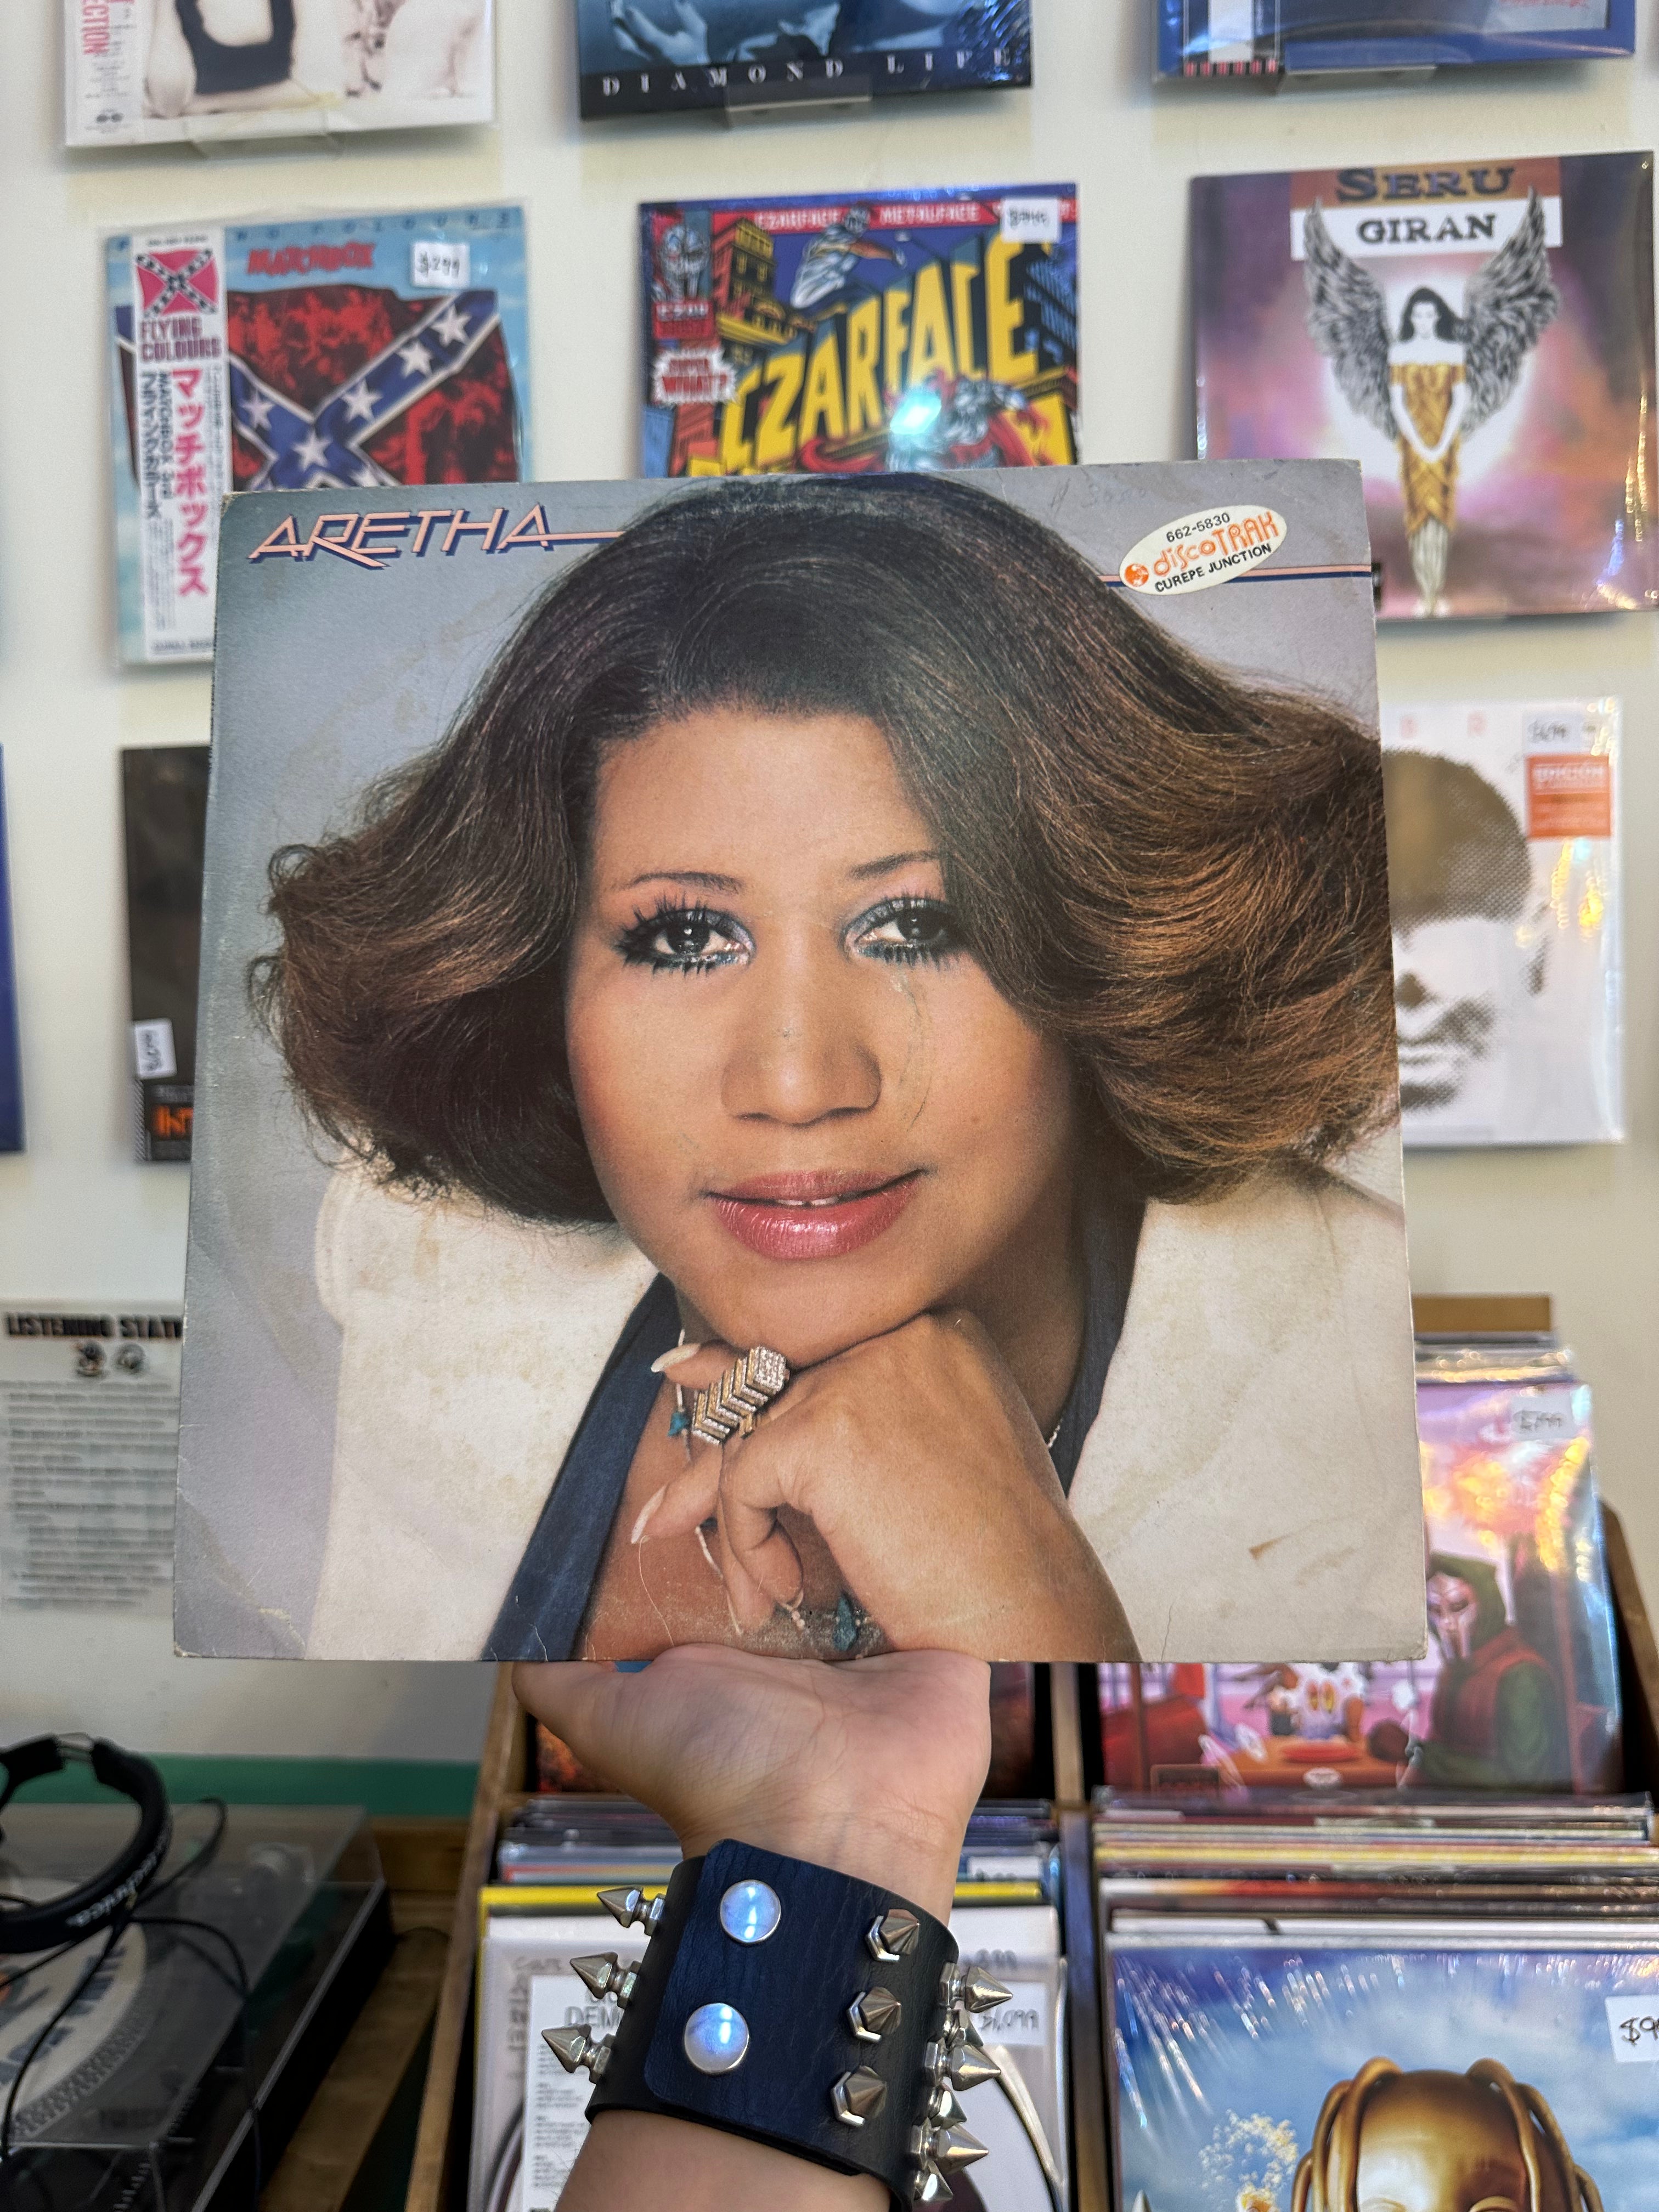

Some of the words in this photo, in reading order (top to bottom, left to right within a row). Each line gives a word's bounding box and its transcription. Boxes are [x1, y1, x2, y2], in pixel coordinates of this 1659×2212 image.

[603, 58, 844, 97] DIAMOND
[887, 48, 1011, 74] LIFE
[1335, 166, 1515, 203] SERU
[1358, 215, 1498, 246] GIRAN
[246, 240, 376, 276] MATCHBOX
[140, 316, 202, 340] FLYING
[140, 337, 221, 363] COLOURS
[718, 235, 1038, 476] CZARFACE
[171, 367, 209, 597] マッチボックス
[248, 501, 554, 571] ARETHA
[1166, 512, 1231, 543] 662-5830
[1154, 567, 1205, 592] CUREPE
[1209, 543, 1272, 574] JUNCTION
[1619, 2015, 1659, 2047] $9
